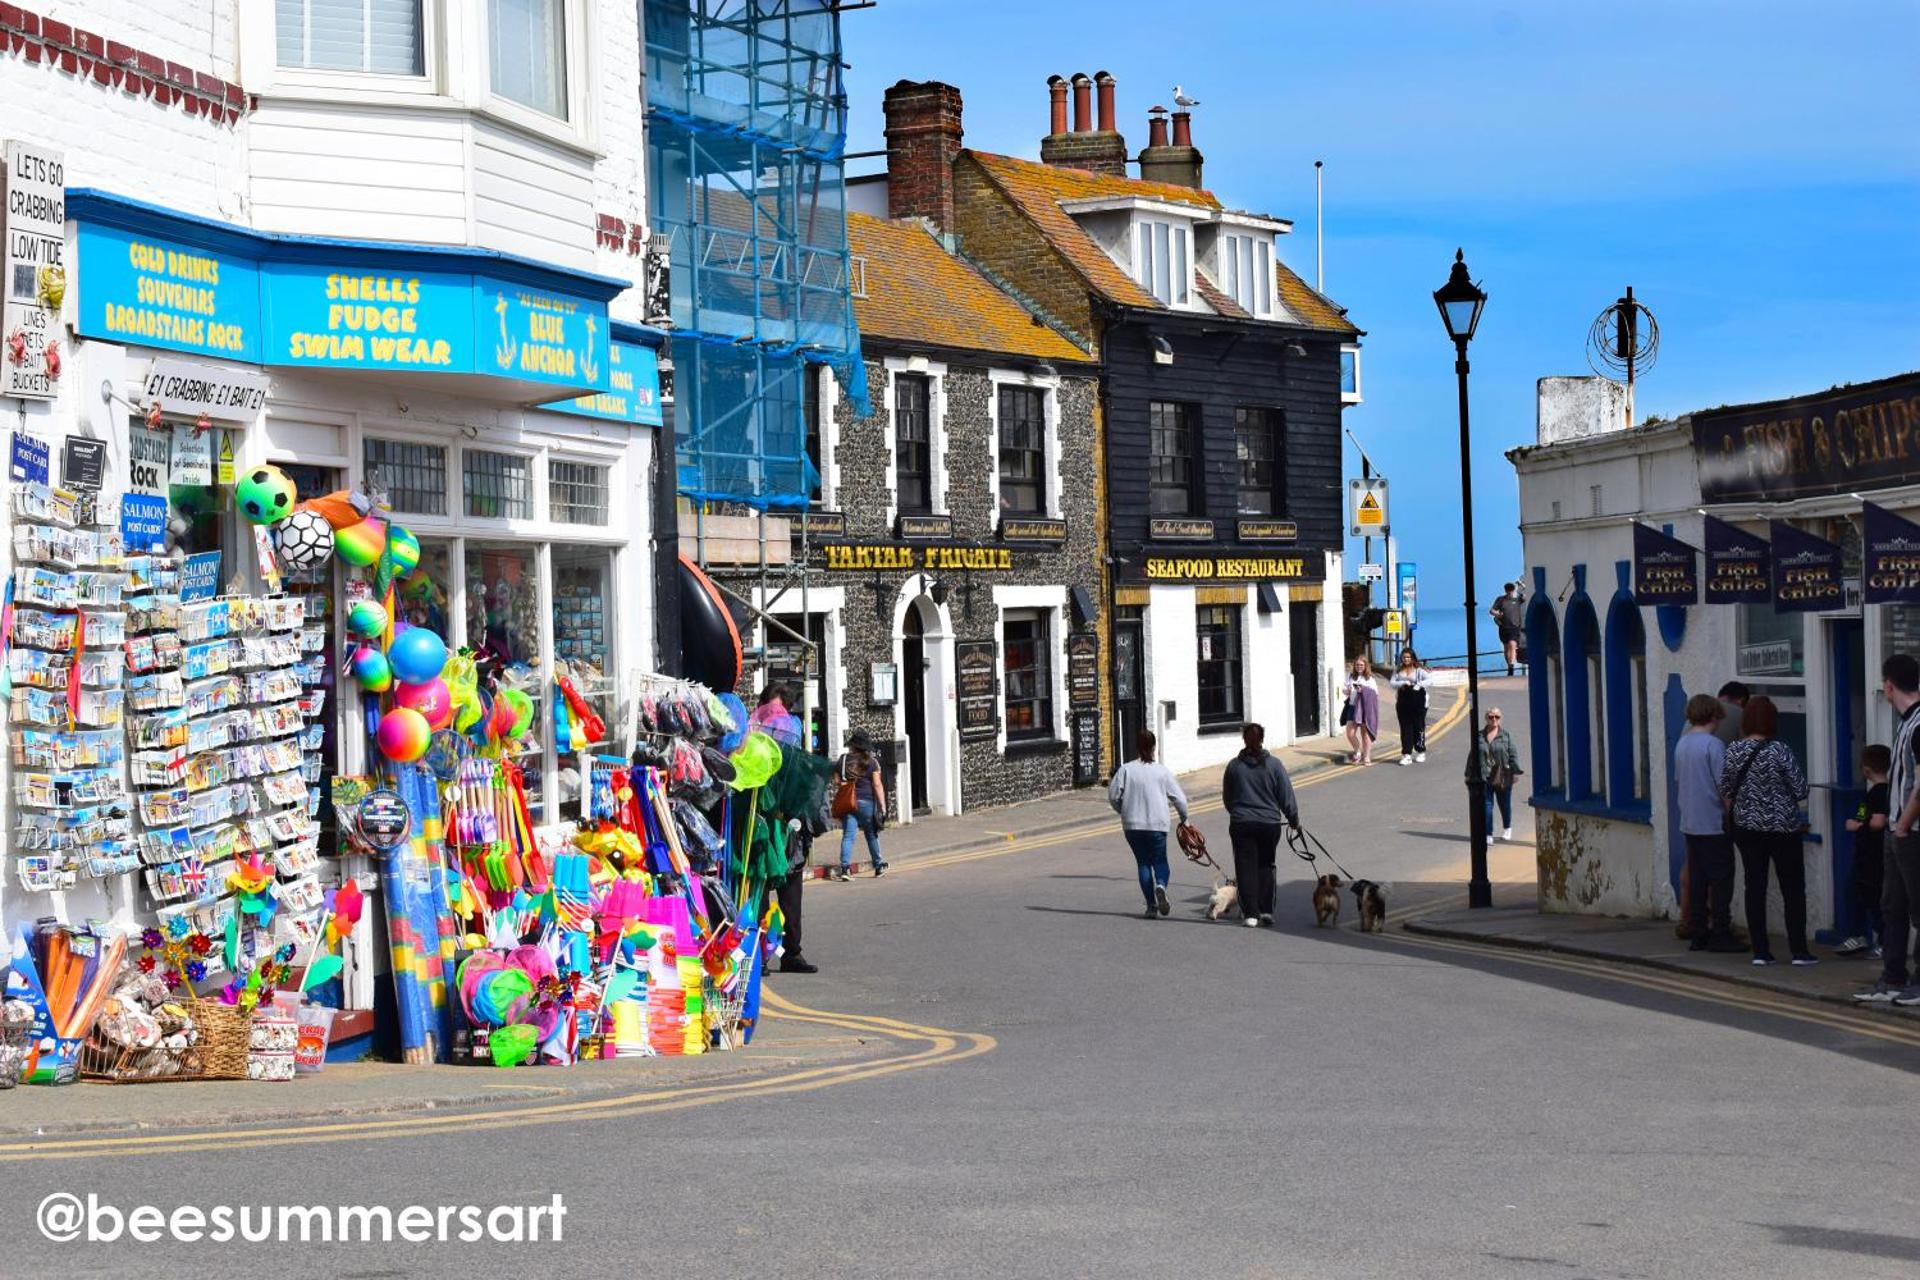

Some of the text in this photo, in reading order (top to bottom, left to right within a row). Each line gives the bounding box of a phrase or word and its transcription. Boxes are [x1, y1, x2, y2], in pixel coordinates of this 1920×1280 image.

[17, 152, 64, 187] LETS GO
[10, 189, 63, 225] CRABBING
[11, 232, 64, 266] LOW TIDE
[130, 241, 219, 285] COLD DRINKS
[137, 275, 215, 316] SOUVENIRS
[325, 273, 420, 304] SHELLS
[23, 309, 46, 328] LINES
[105, 302, 244, 350] BROADSTAIRS ROCK
[328, 304, 417, 333] FUDGE
[530, 311, 564, 345] BLUE
[23, 352, 41, 369] BAIT
[289, 332, 451, 365] SWIM WEAR
[520, 342, 576, 377] ANCHOR
[12, 372, 50, 392] BUCKETS
[148, 374, 165, 396] £1
[165, 376, 216, 403] CRABBING
[215, 384, 231, 405] £1
[230, 386, 255, 408] BAIT
[130, 460, 158, 489] ROCK
[124, 503, 164, 520] SALMON
[184, 561, 216, 577] SALMON
[825, 545, 1011, 569] TARTAR FRIGATE
[1147, 558, 1303, 578] SEAFOOD RESTAURANT
